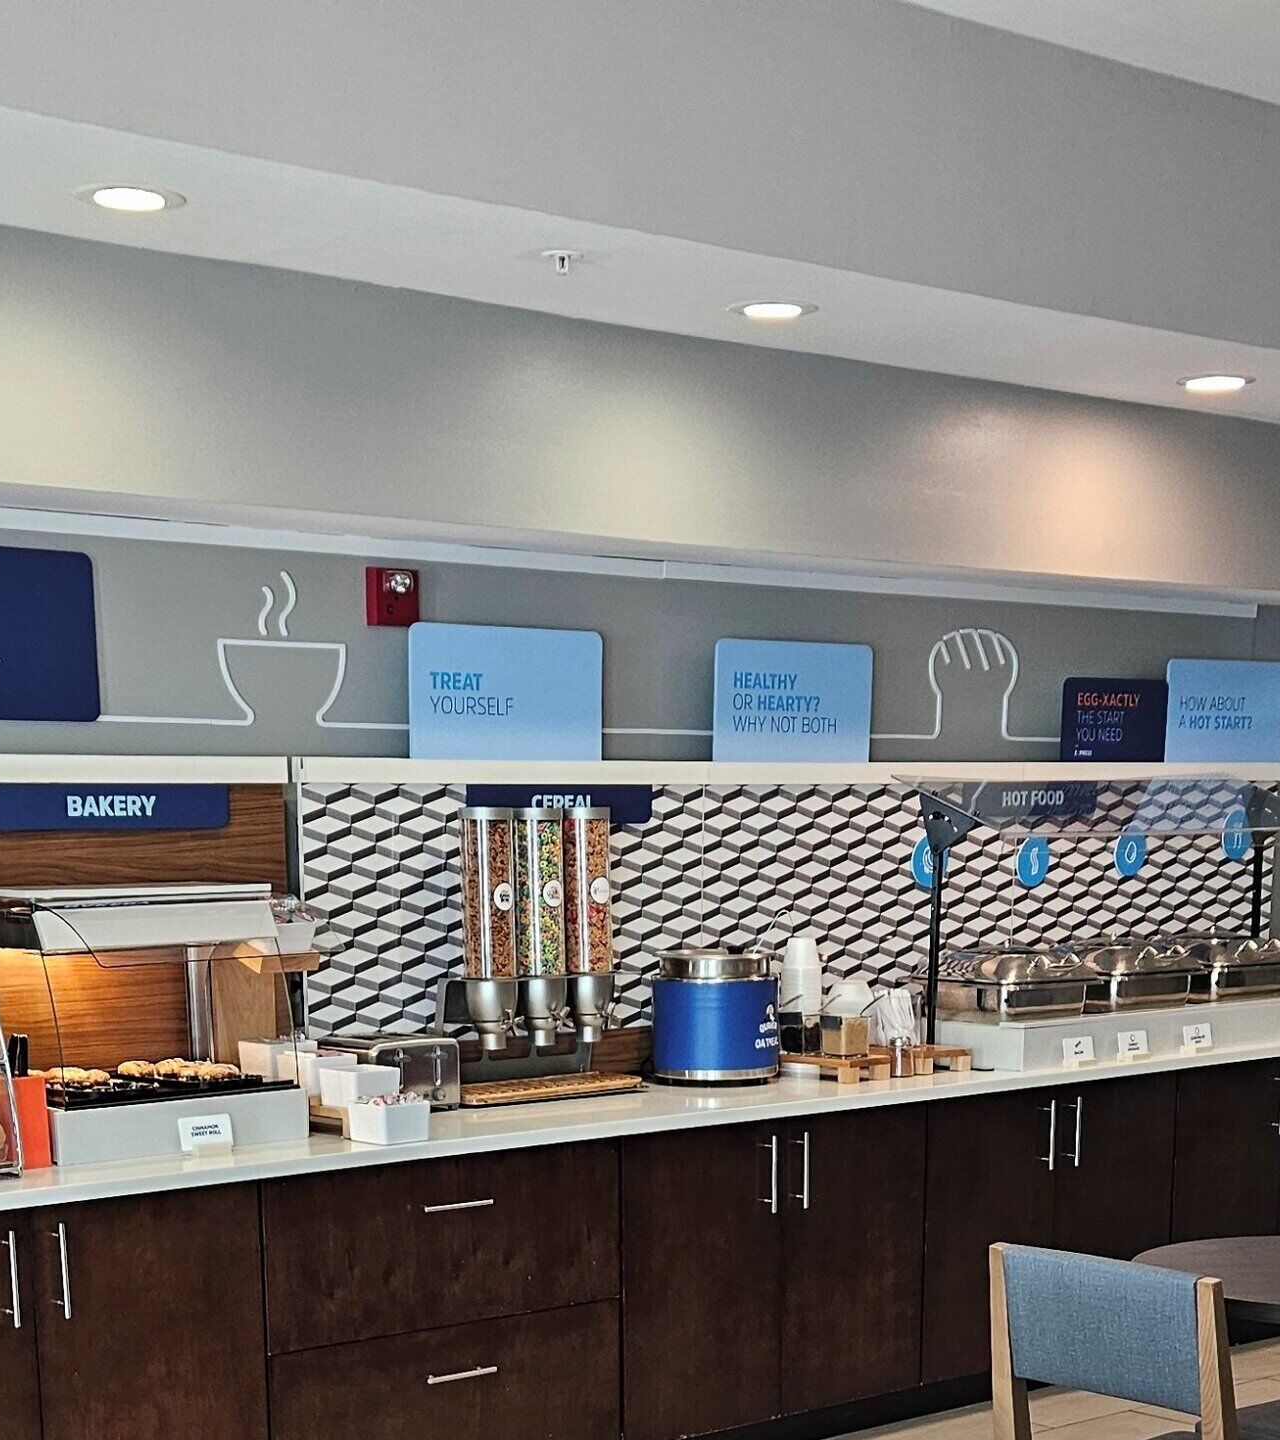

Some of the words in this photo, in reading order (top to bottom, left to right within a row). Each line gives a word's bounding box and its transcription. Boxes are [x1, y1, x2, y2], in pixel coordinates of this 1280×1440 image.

[429, 671, 483, 691] TREAT
[733, 671, 797, 690] HEALTHY
[429, 695, 514, 716] YOURSELF
[733, 693, 753, 711] OR
[757, 695, 820, 712] HEARTY?
[1077, 692, 1140, 707] EGG-XACTLY
[1180, 696, 1207, 711] HOW
[1209, 696, 1246, 711] ABOUT
[733, 715, 767, 732] WHY
[771, 716, 797, 733] NOT
[802, 716, 837, 734] BOTH
[1077, 710, 1095, 724] THE
[1097, 710, 1125, 725] START
[1179, 715, 1186, 728] A
[1189, 715, 1211, 729] HOT
[1214, 715, 1253, 730] START?
[1076, 727, 1096, 741] YOU
[1099, 727, 1123, 741] NEED
[66, 795, 156, 817] BAKERY
[1002, 790, 1028, 807] HOT
[1031, 790, 1064, 806] FOOD
